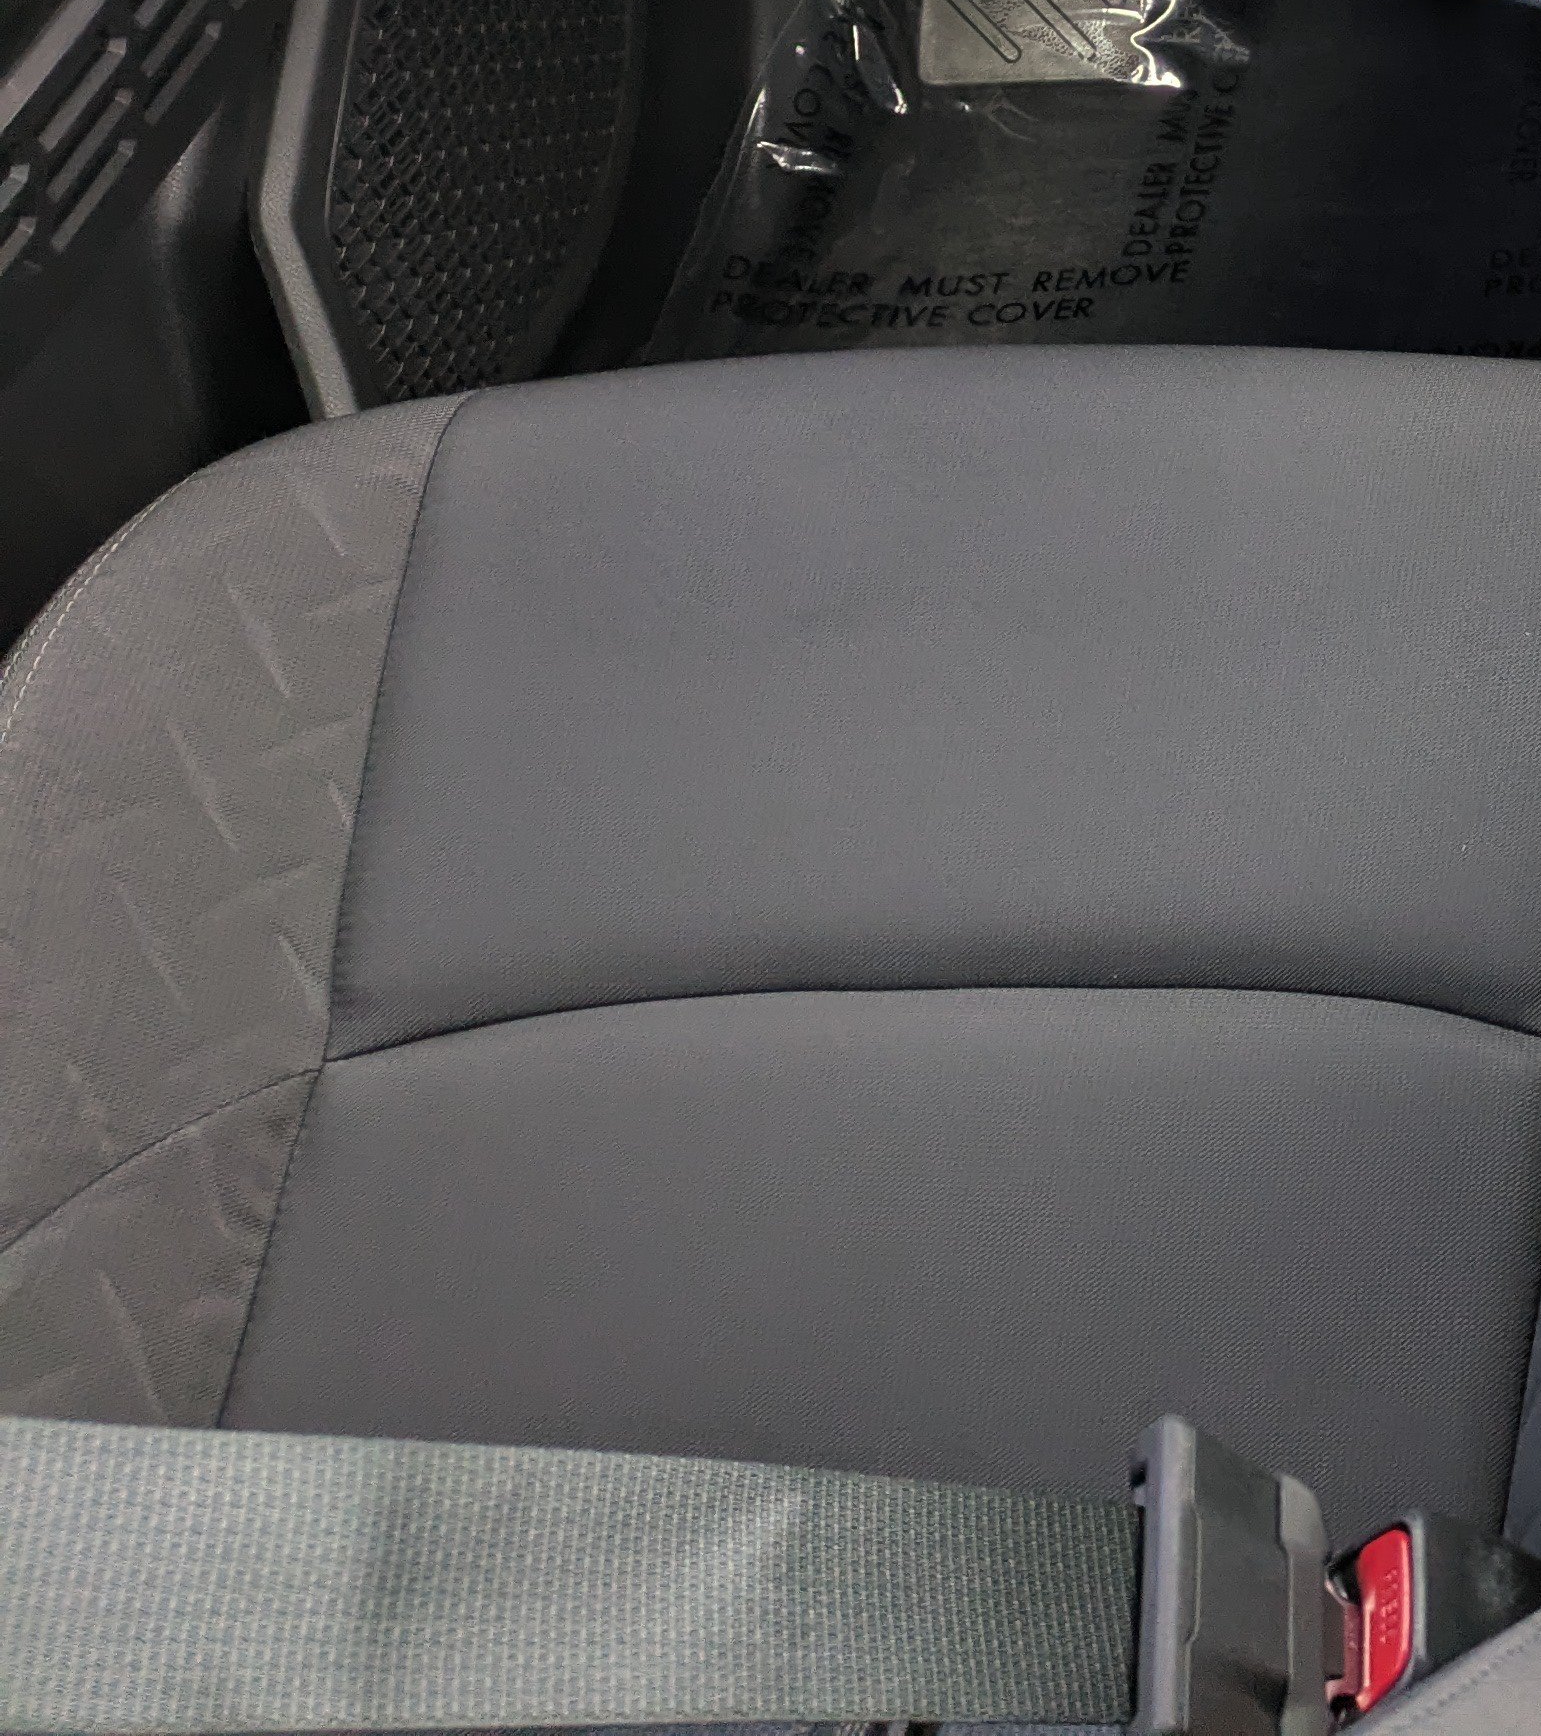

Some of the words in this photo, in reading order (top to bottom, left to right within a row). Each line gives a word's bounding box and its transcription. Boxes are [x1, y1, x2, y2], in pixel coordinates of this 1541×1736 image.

[900, 271, 1010, 297] MUST
[1031, 258, 1192, 295] REMOVE
[967, 296, 1095, 328] COVER
